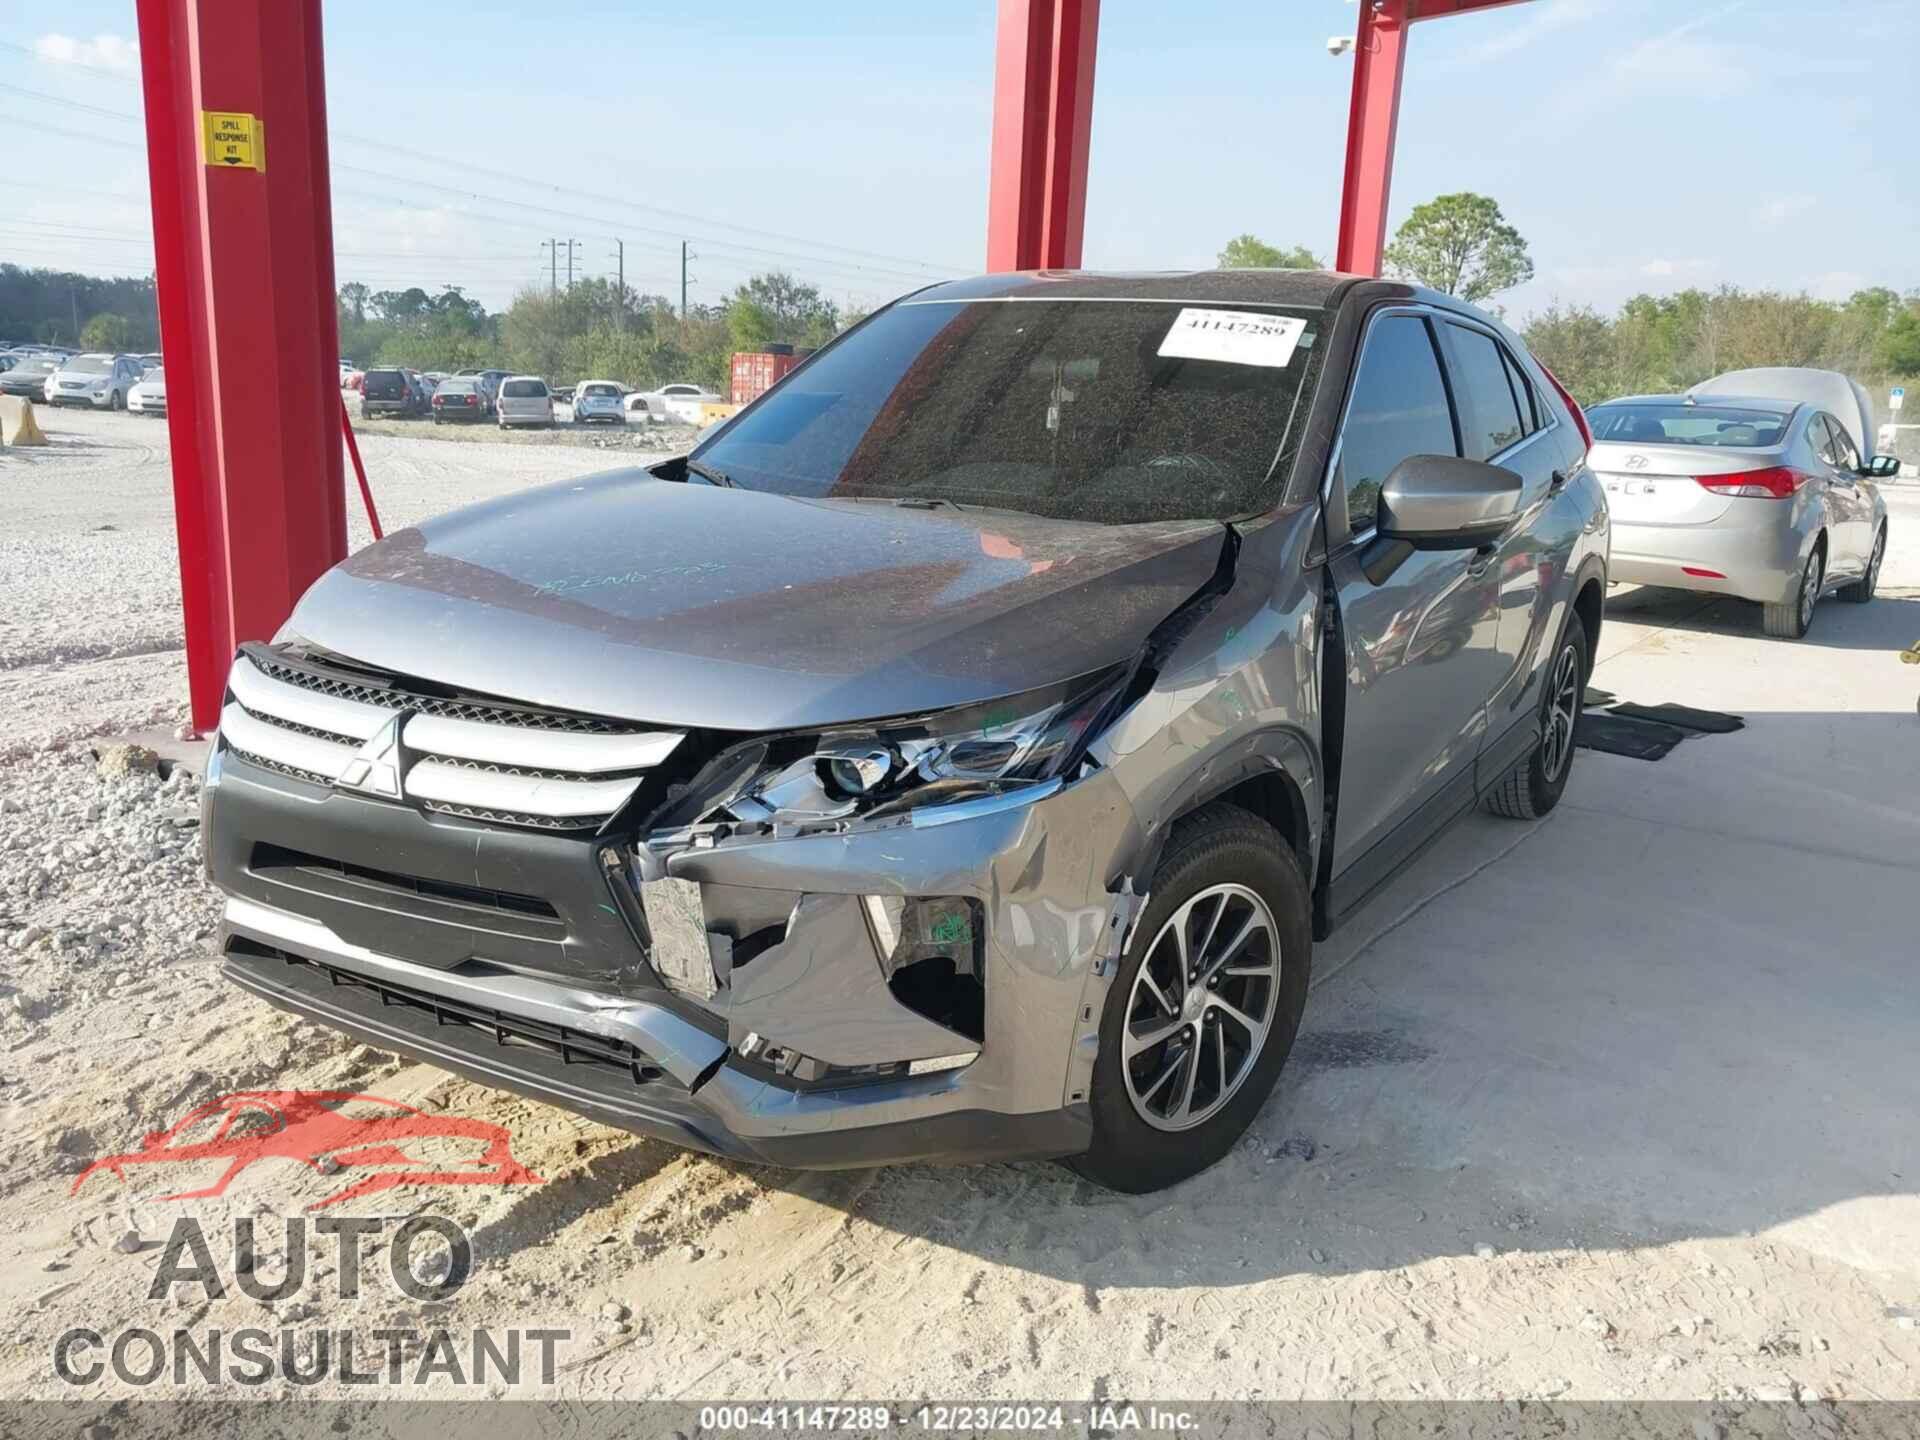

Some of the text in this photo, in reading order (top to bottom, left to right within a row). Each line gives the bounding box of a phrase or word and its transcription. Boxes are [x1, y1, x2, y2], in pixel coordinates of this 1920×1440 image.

[222, 121, 239, 130] SPILL
[215, 132, 248, 142] RESPONSE
[227, 145, 237, 154] KIT
[1186, 320, 1286, 336] 41147289
